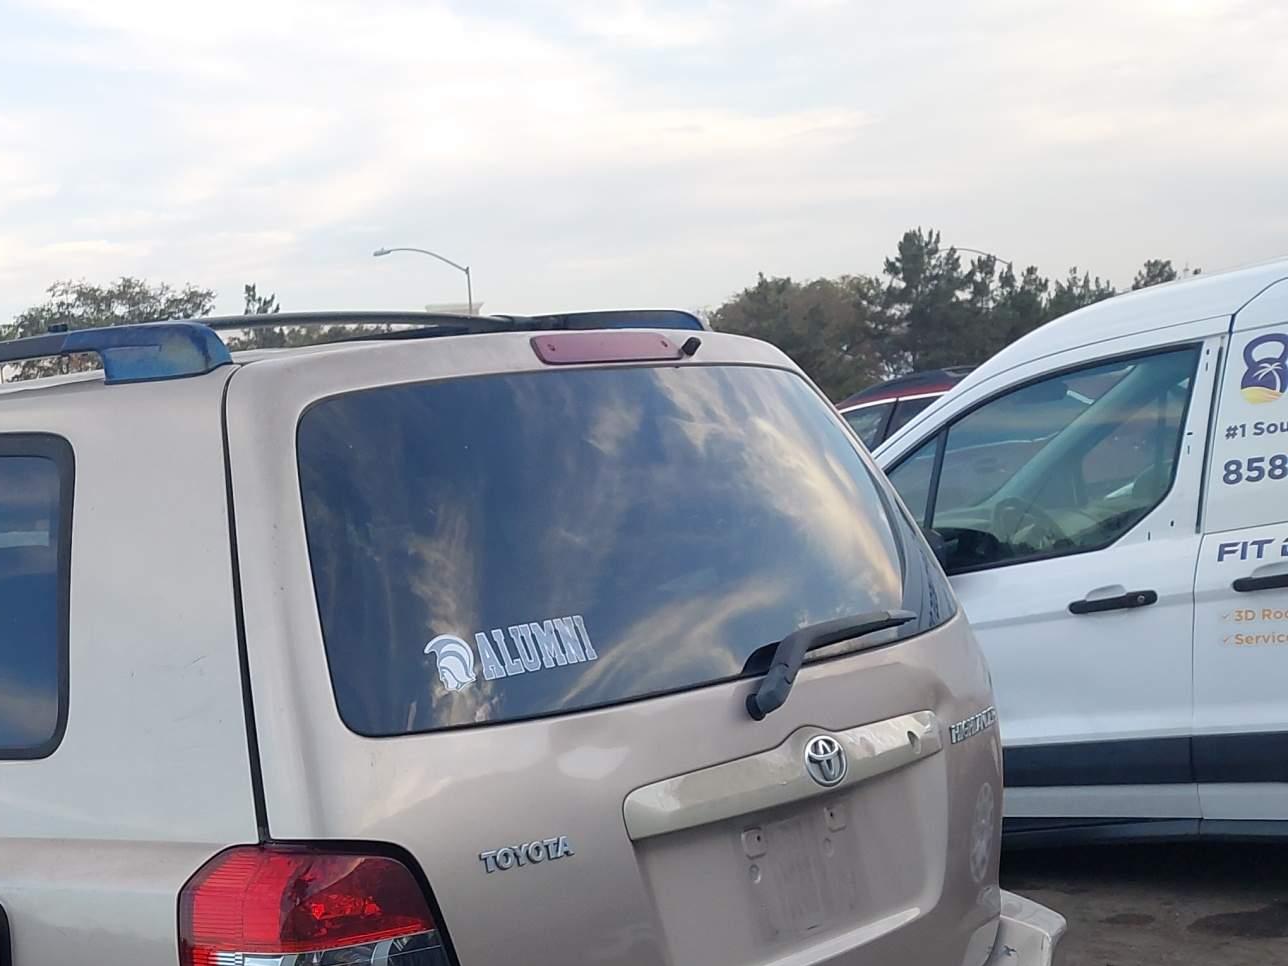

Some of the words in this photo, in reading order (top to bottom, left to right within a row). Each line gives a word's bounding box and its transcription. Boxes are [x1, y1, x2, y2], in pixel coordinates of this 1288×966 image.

[1224, 423, 1247, 440] #1
[1222, 454, 1288, 485] 858
[1217, 538, 1275, 562] FIT
[1234, 609, 1257, 621] 3D
[475, 615, 598, 681] ALUMNI
[1234, 632, 1288, 645] Servic
[479, 836, 576, 873] TOYOTA
